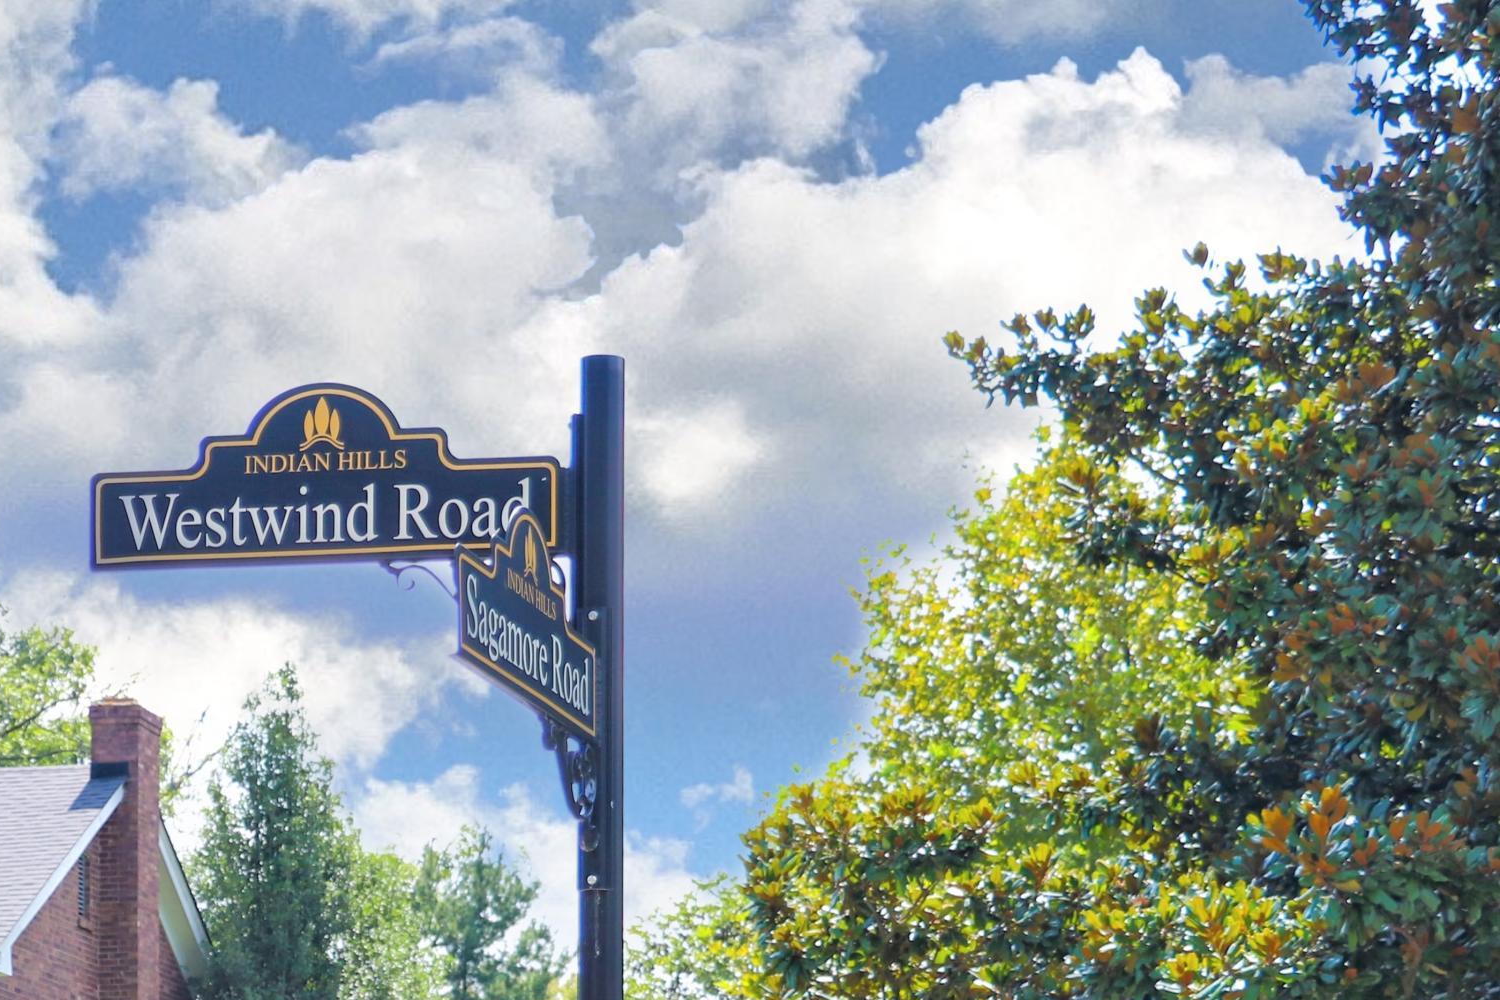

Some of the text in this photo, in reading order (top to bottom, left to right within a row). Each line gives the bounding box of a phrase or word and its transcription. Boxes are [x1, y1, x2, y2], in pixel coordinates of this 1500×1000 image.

[244, 450, 407, 474] INDIAN HILLS
[118, 483, 378, 551] Westwind
[507, 568, 557, 621] INDIAN HILLS
[466, 574, 590, 716] Sagamore Road
